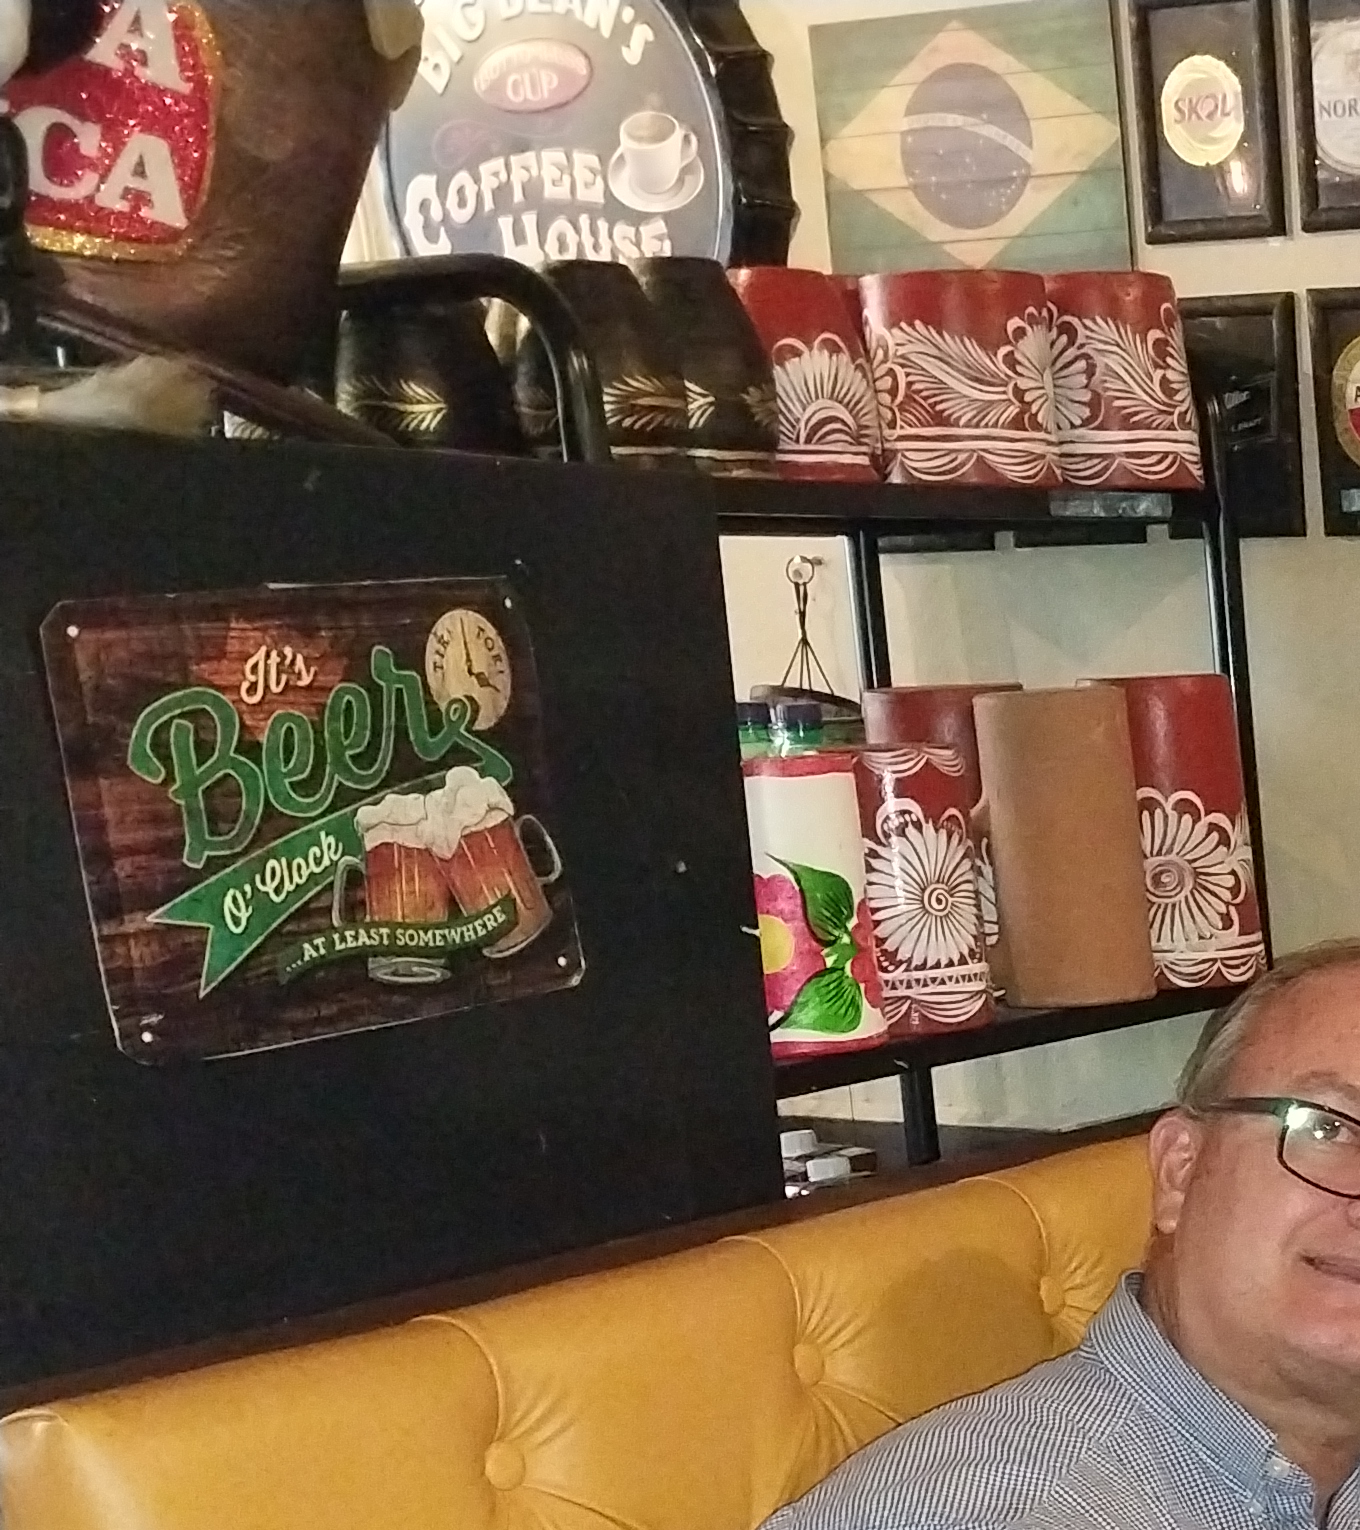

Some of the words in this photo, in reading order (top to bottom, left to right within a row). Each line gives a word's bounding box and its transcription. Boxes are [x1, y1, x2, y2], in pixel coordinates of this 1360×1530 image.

[418, 0, 486, 94] BIG
[506, 68, 559, 103] CUP
[1174, 92, 1231, 124] SKOL
[404, 147, 605, 256] COFFEE
[498, 211, 672, 266] HOUSE
[241, 646, 317, 705] It's
[127, 645, 512, 868] Beer
[332, 928, 390, 951] LEAST
[395, 905, 507, 947] SOMEWHERE
